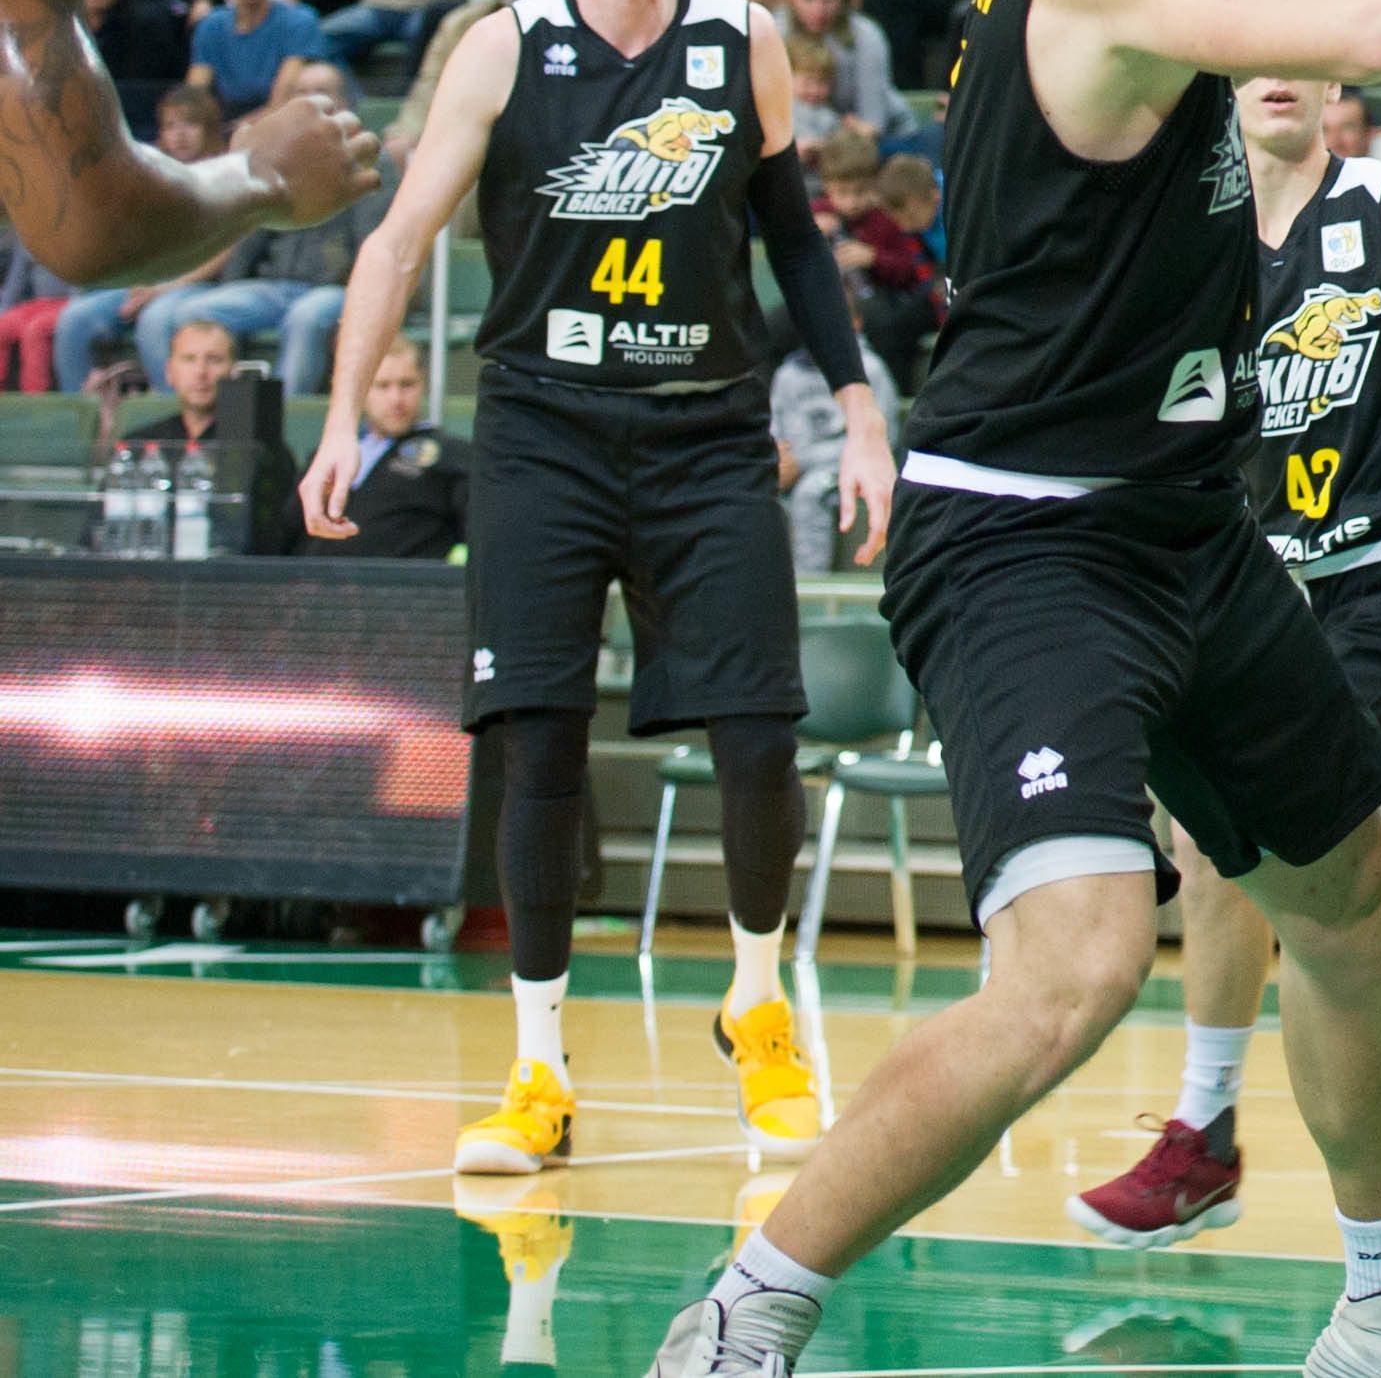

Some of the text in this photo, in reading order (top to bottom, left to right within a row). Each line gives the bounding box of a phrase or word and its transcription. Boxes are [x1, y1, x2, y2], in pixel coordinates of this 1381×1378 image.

[565, 191, 648, 214] БАСКЕТ
[591, 237, 664, 306] 44
[608, 320, 710, 346] ALTIS
[623, 350, 695, 366] HOLDING
[1282, 516, 1372, 562] ALTIS
